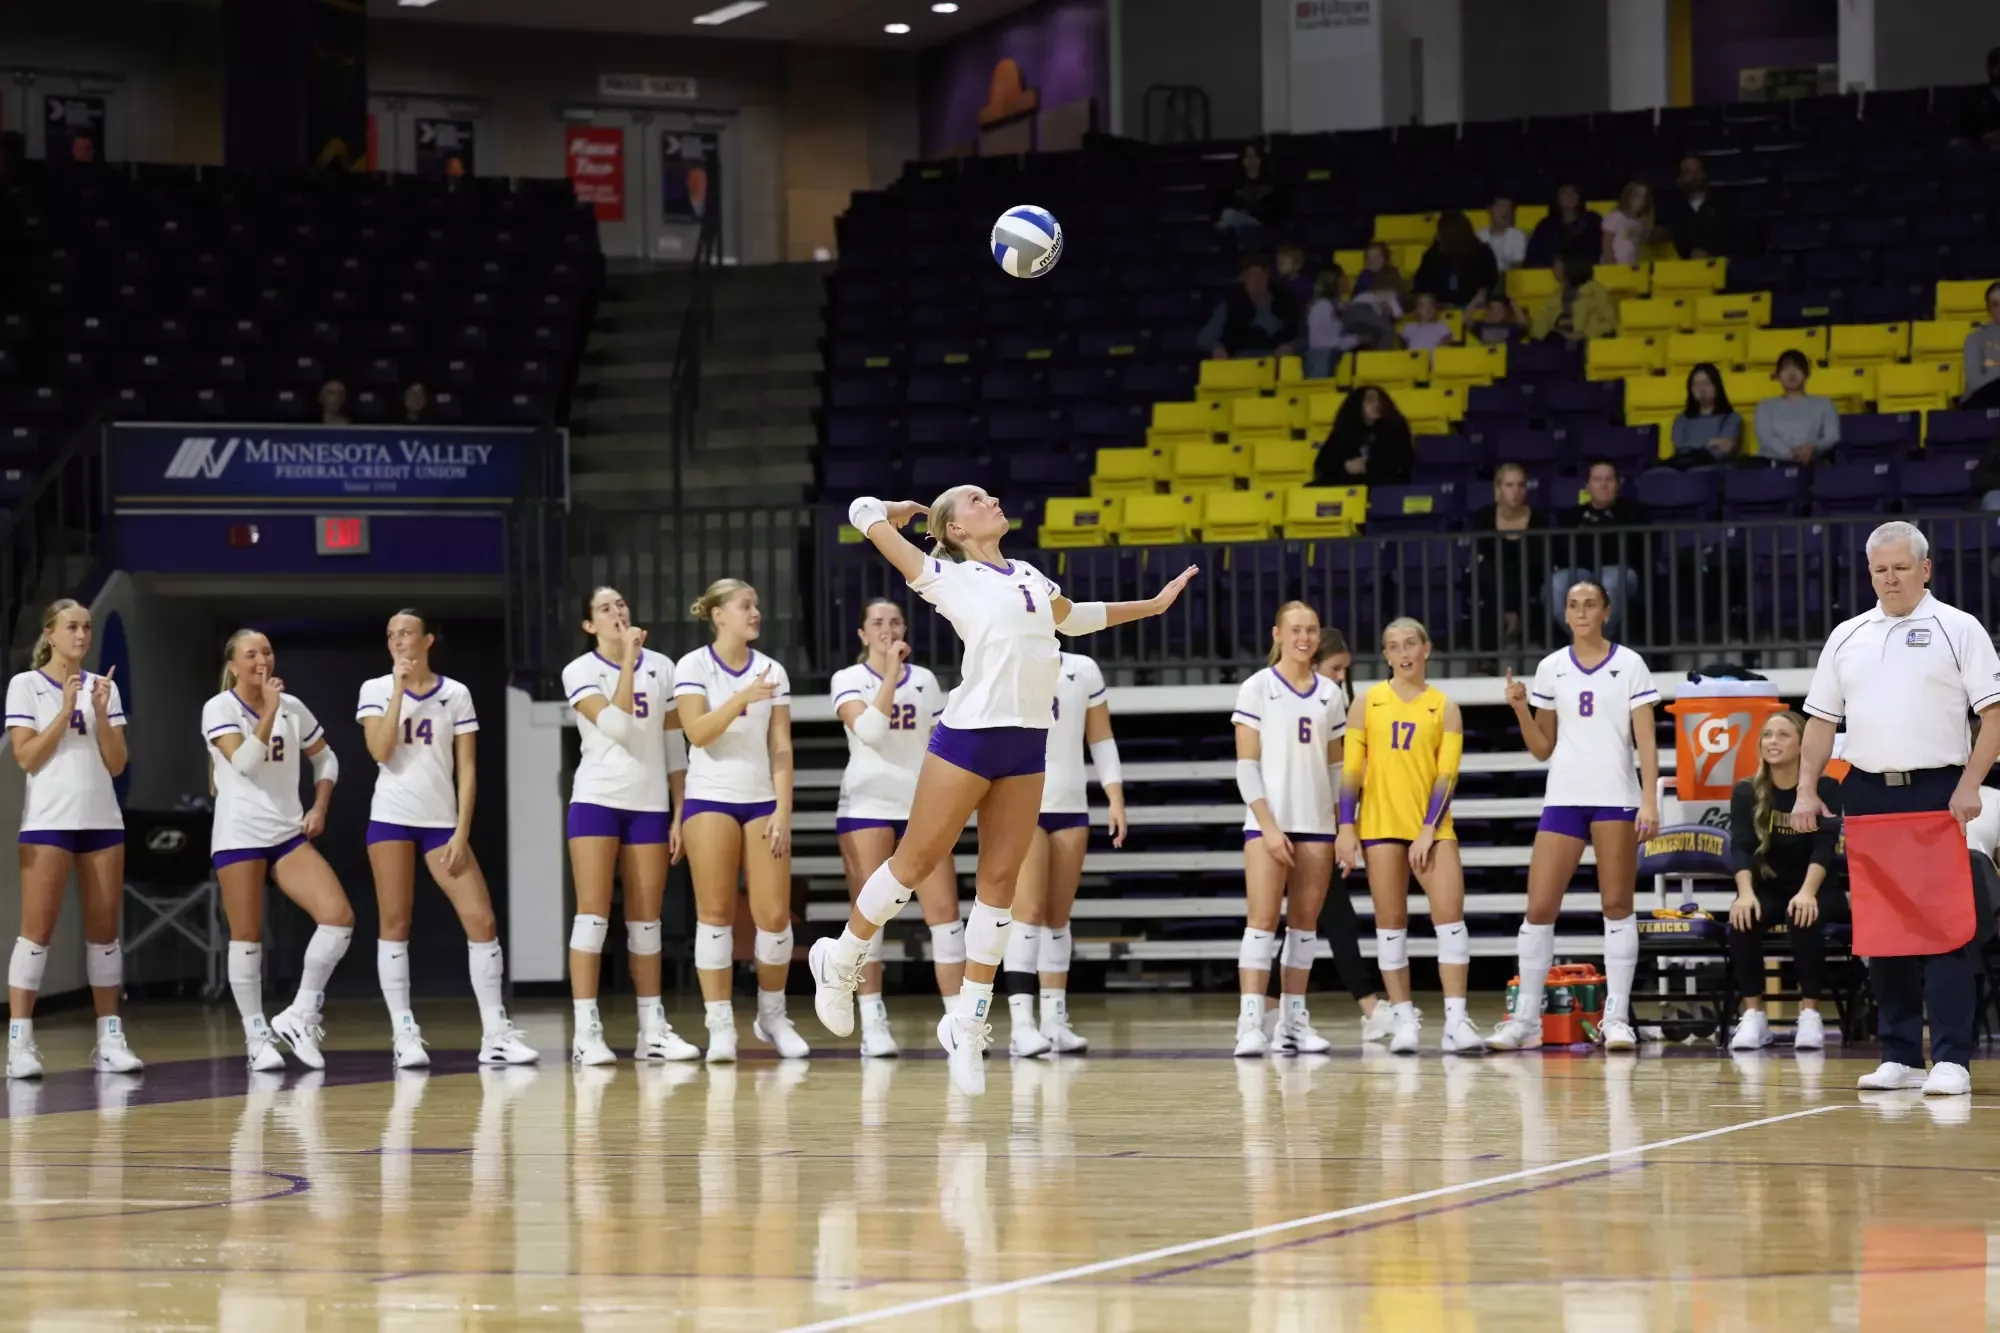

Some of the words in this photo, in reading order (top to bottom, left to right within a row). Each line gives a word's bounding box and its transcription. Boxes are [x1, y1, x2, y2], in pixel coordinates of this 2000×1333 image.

[1039, 231, 1062, 268] molten
[244, 438, 392, 464] MINNESOTA
[399, 440, 493, 465] VALLEY
[275, 465, 348, 479] FEDERAL
[352, 466, 410, 479] CREDIT
[415, 466, 467, 479] UNION
[1018, 584, 1036, 613] 1
[889, 703, 916, 730] 22
[1579, 691, 1594, 717] 8
[70, 709, 87, 735] 4
[403, 717, 433, 745] 14
[1298, 716, 1312, 744] 6
[1391, 720, 1416, 750] 17
[1698, 717, 1730, 753] G
[264, 735, 284, 762] 2
[1644, 832, 1696, 858] MINNESOTA
[1697, 833, 1724, 856] STATE
